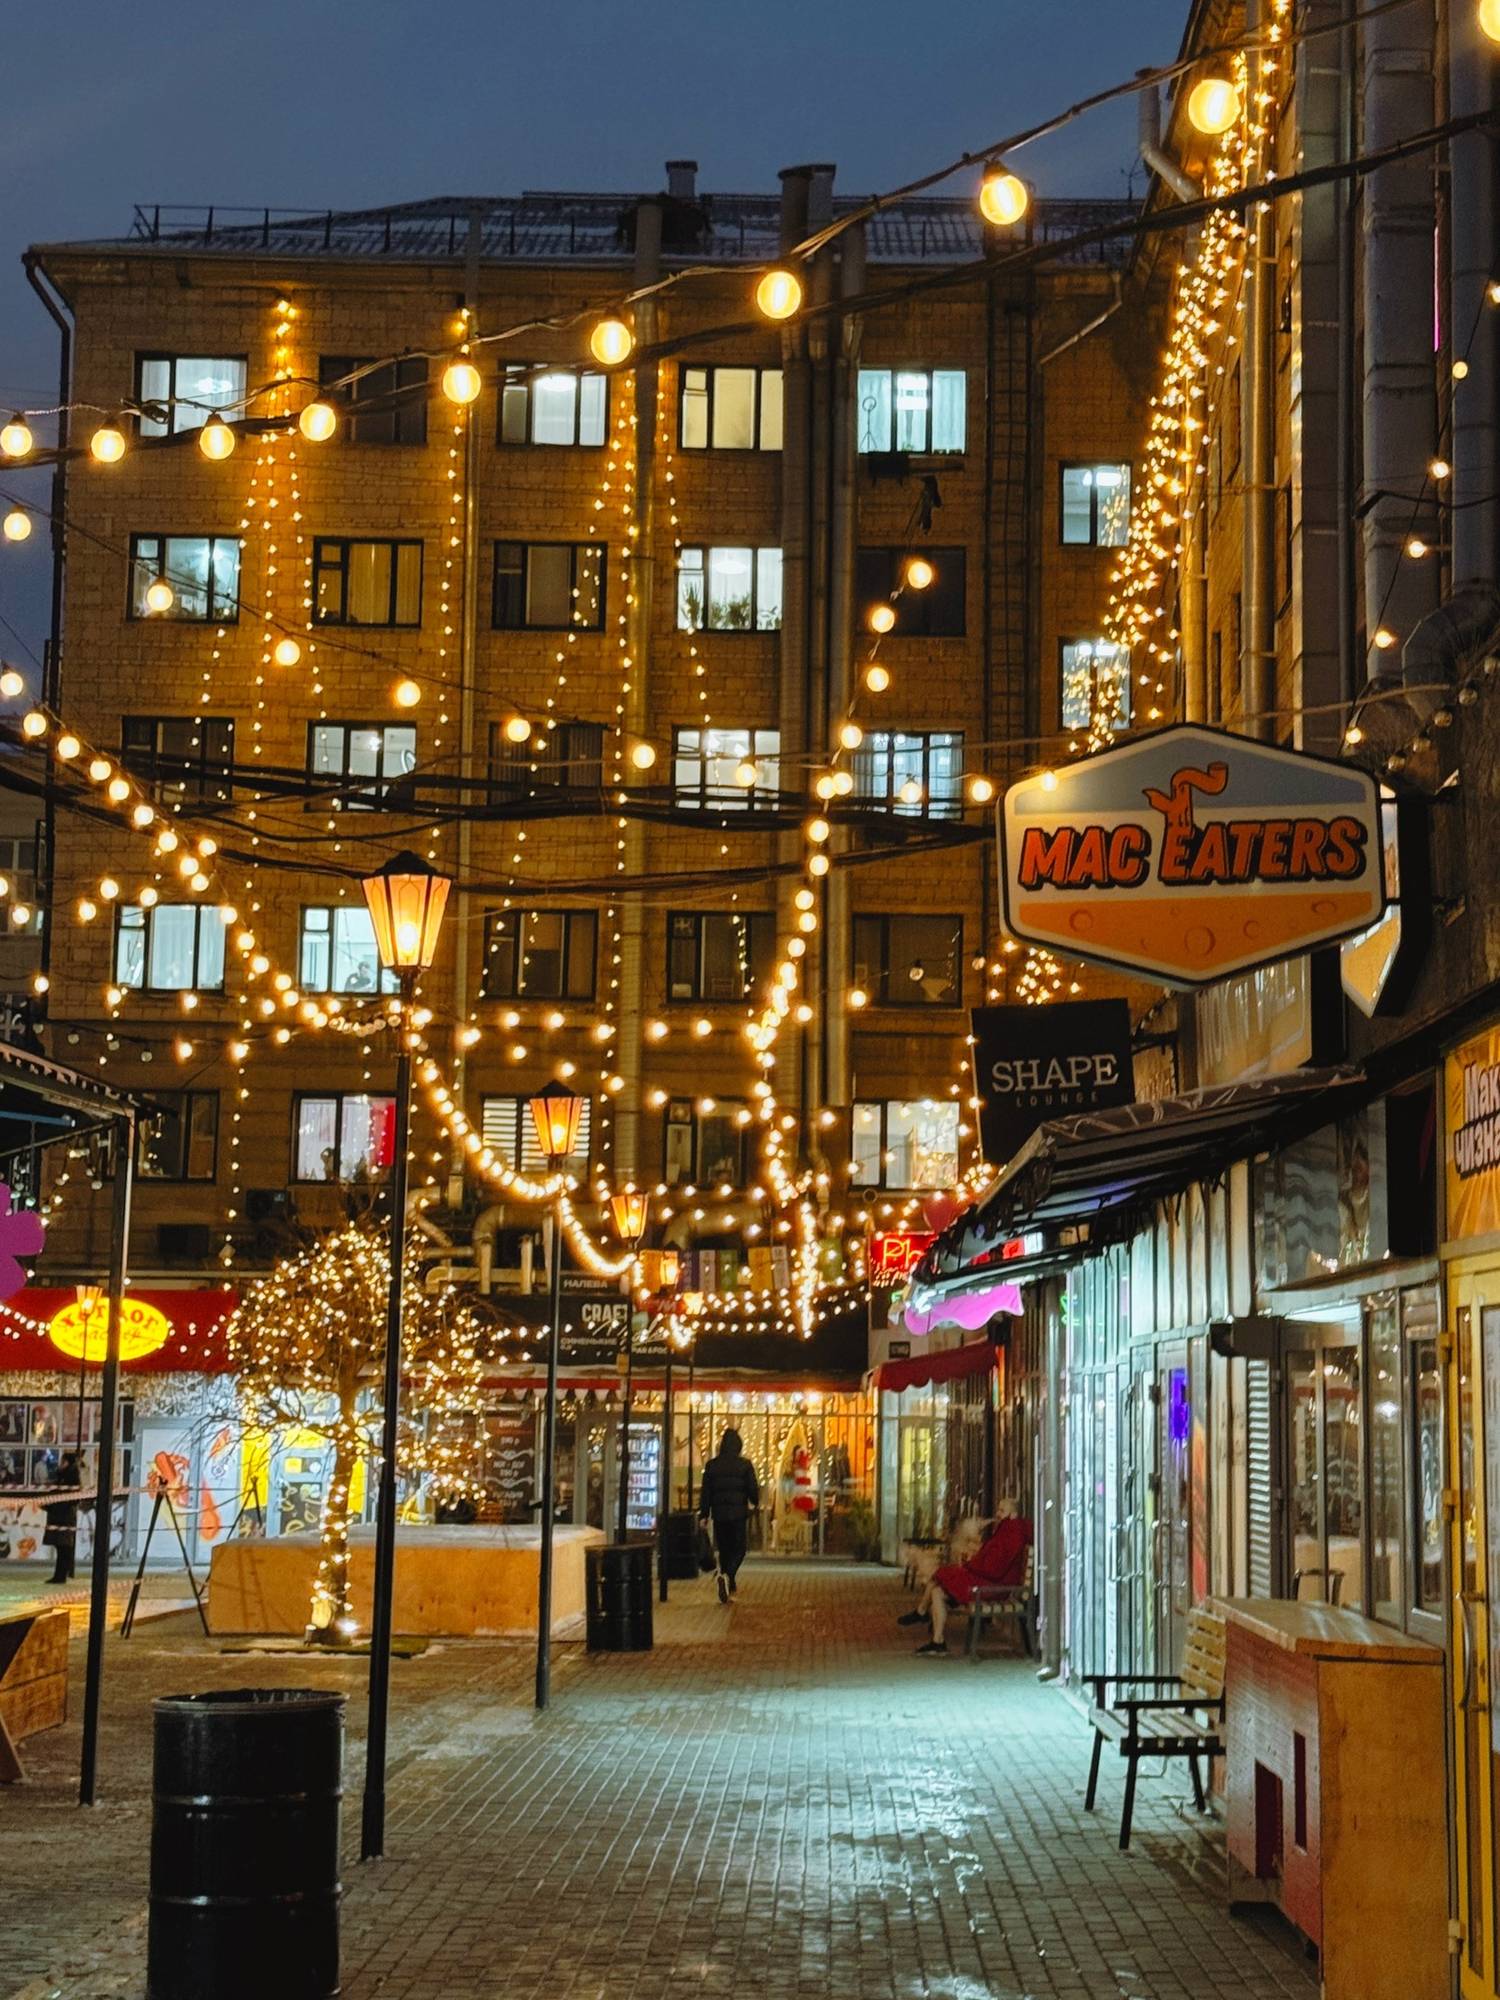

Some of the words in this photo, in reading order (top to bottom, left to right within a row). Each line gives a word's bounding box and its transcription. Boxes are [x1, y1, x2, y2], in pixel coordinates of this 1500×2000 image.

[1018, 823, 1151, 891] MAC
[1158, 815, 1368, 886] EATERS
[991, 1053, 1119, 1093] SHAPE
[1015, 1091, 1099, 1108] LOUNGE
